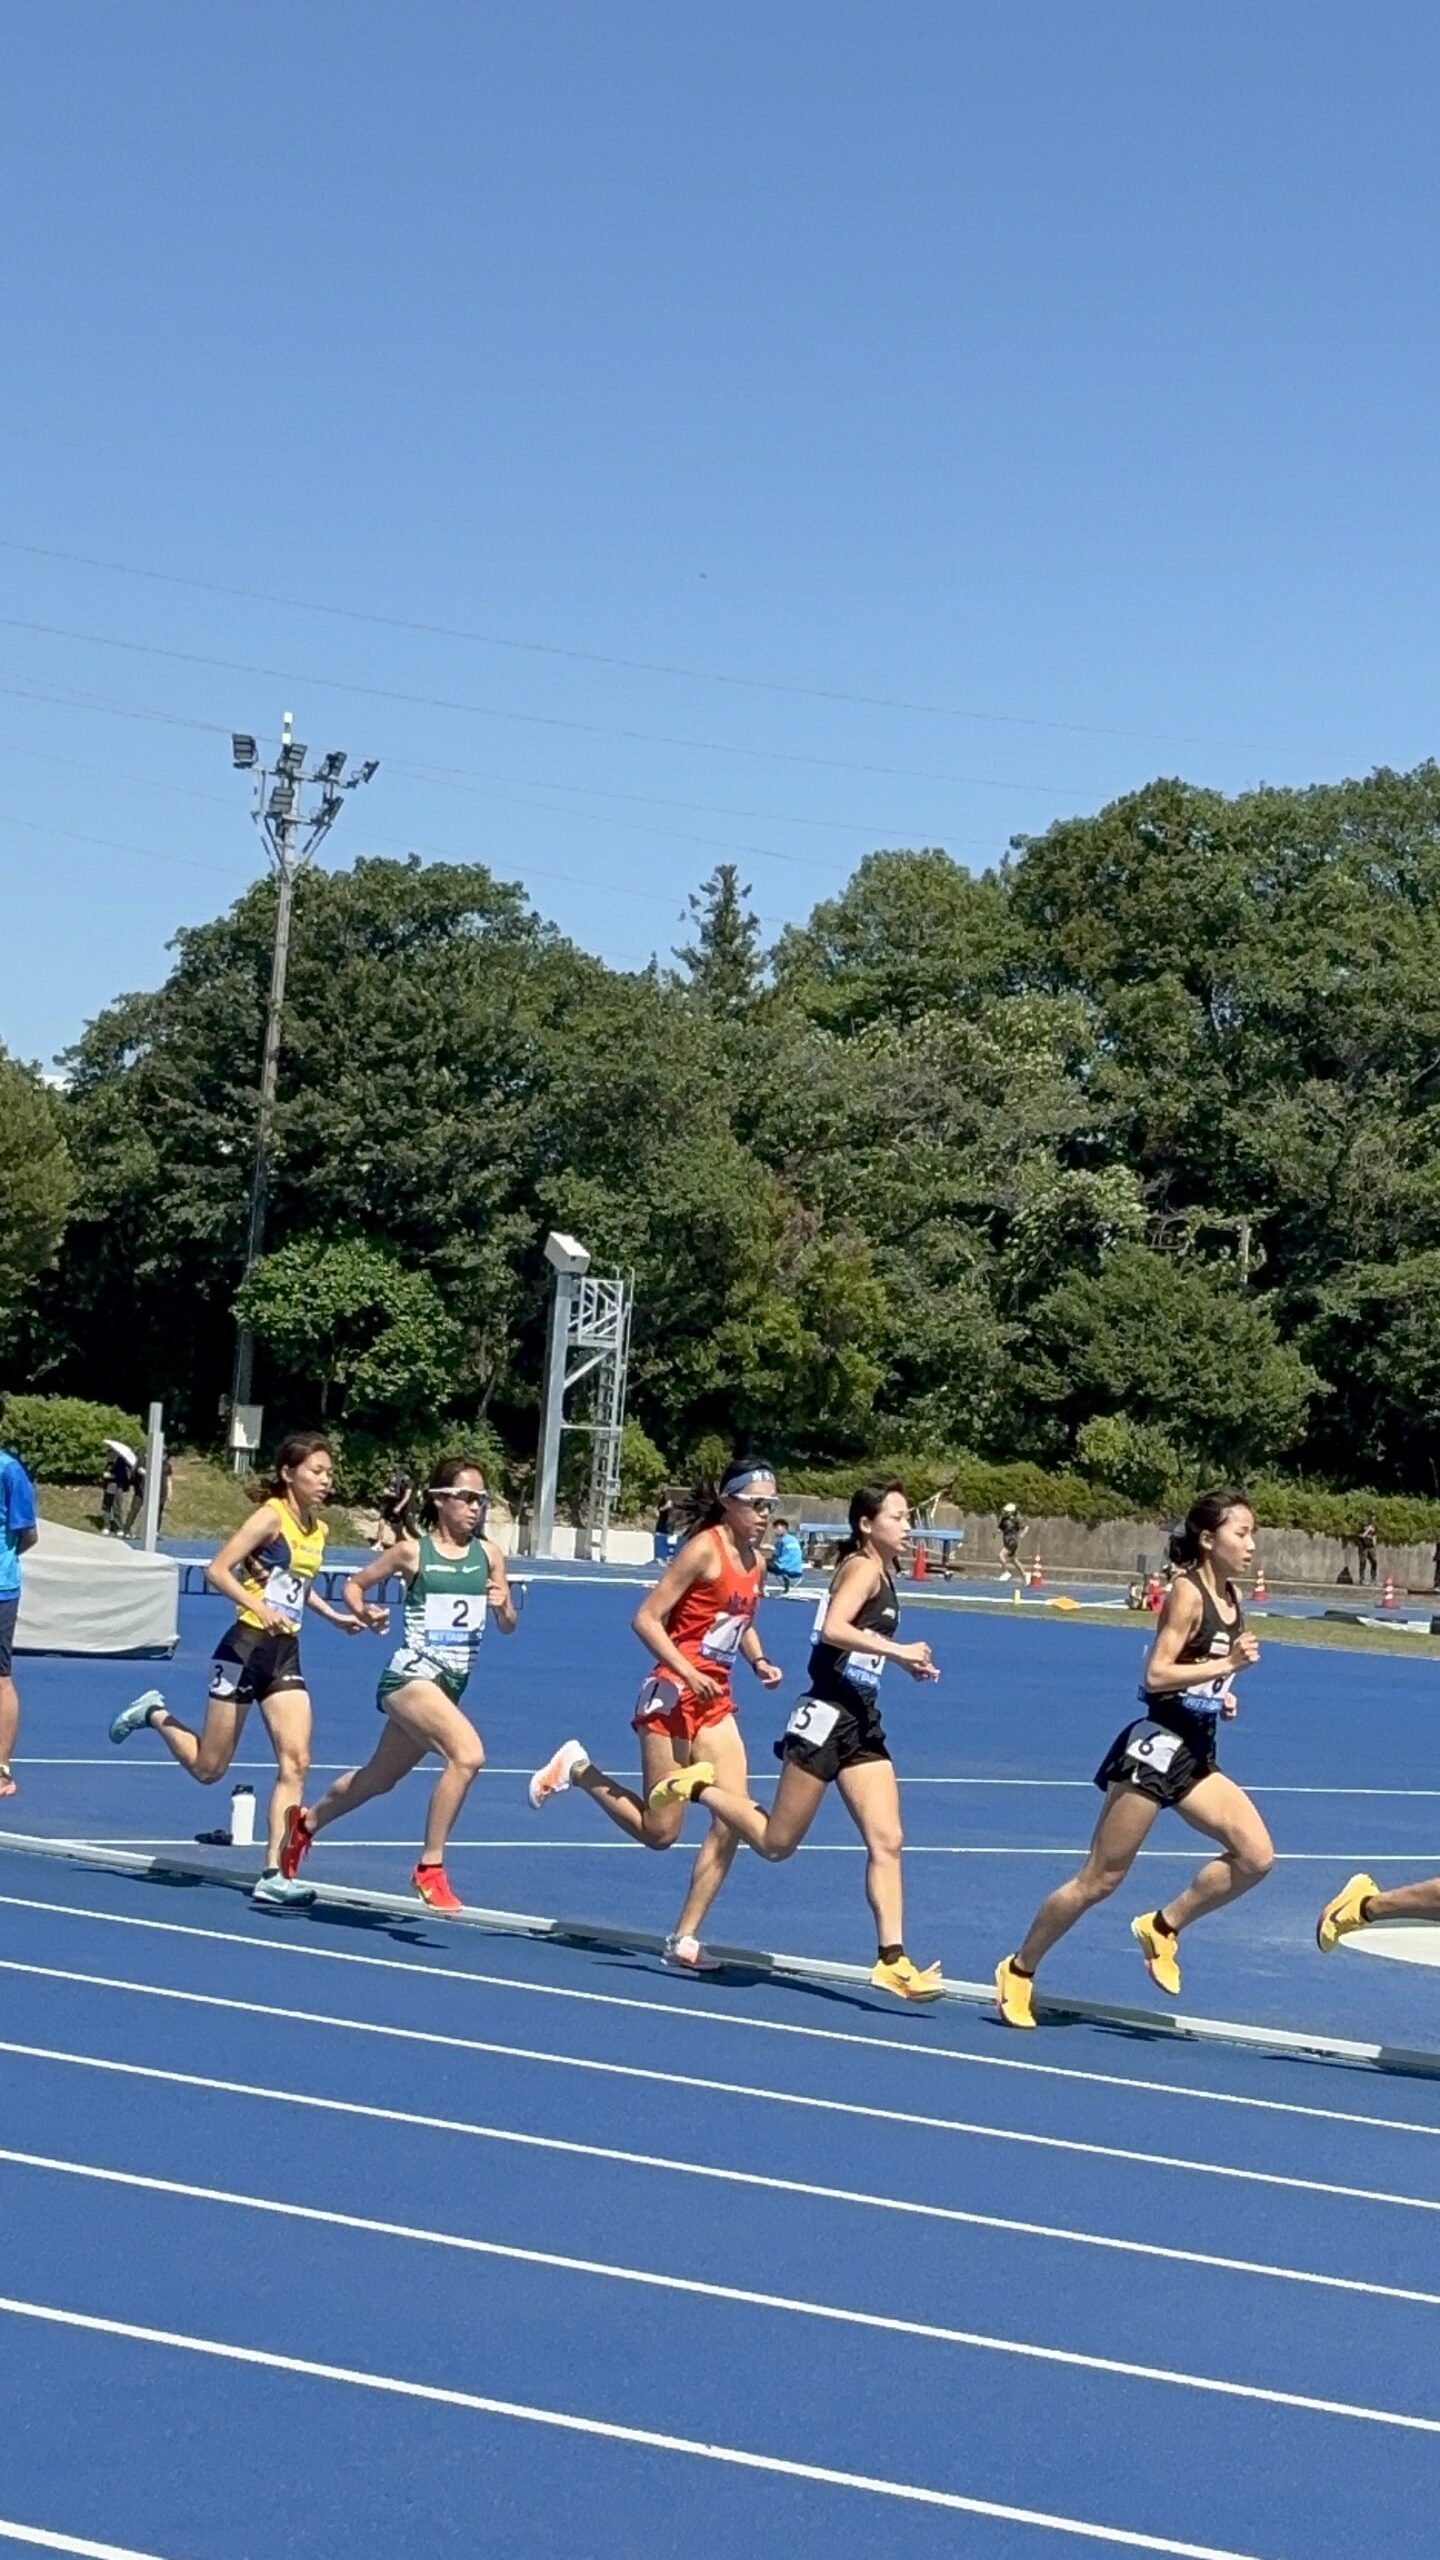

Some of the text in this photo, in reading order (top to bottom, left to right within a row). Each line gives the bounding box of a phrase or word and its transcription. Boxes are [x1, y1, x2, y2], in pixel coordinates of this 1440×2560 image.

[286, 1578, 302, 1604] 3
[452, 1600, 469, 1627] 2
[403, 1648, 424, 1673] 2
[211, 1663, 225, 1689] 3
[647, 1682, 660, 1710] 1
[794, 1701, 817, 1730] 5
[1138, 1730, 1161, 1756] 6
